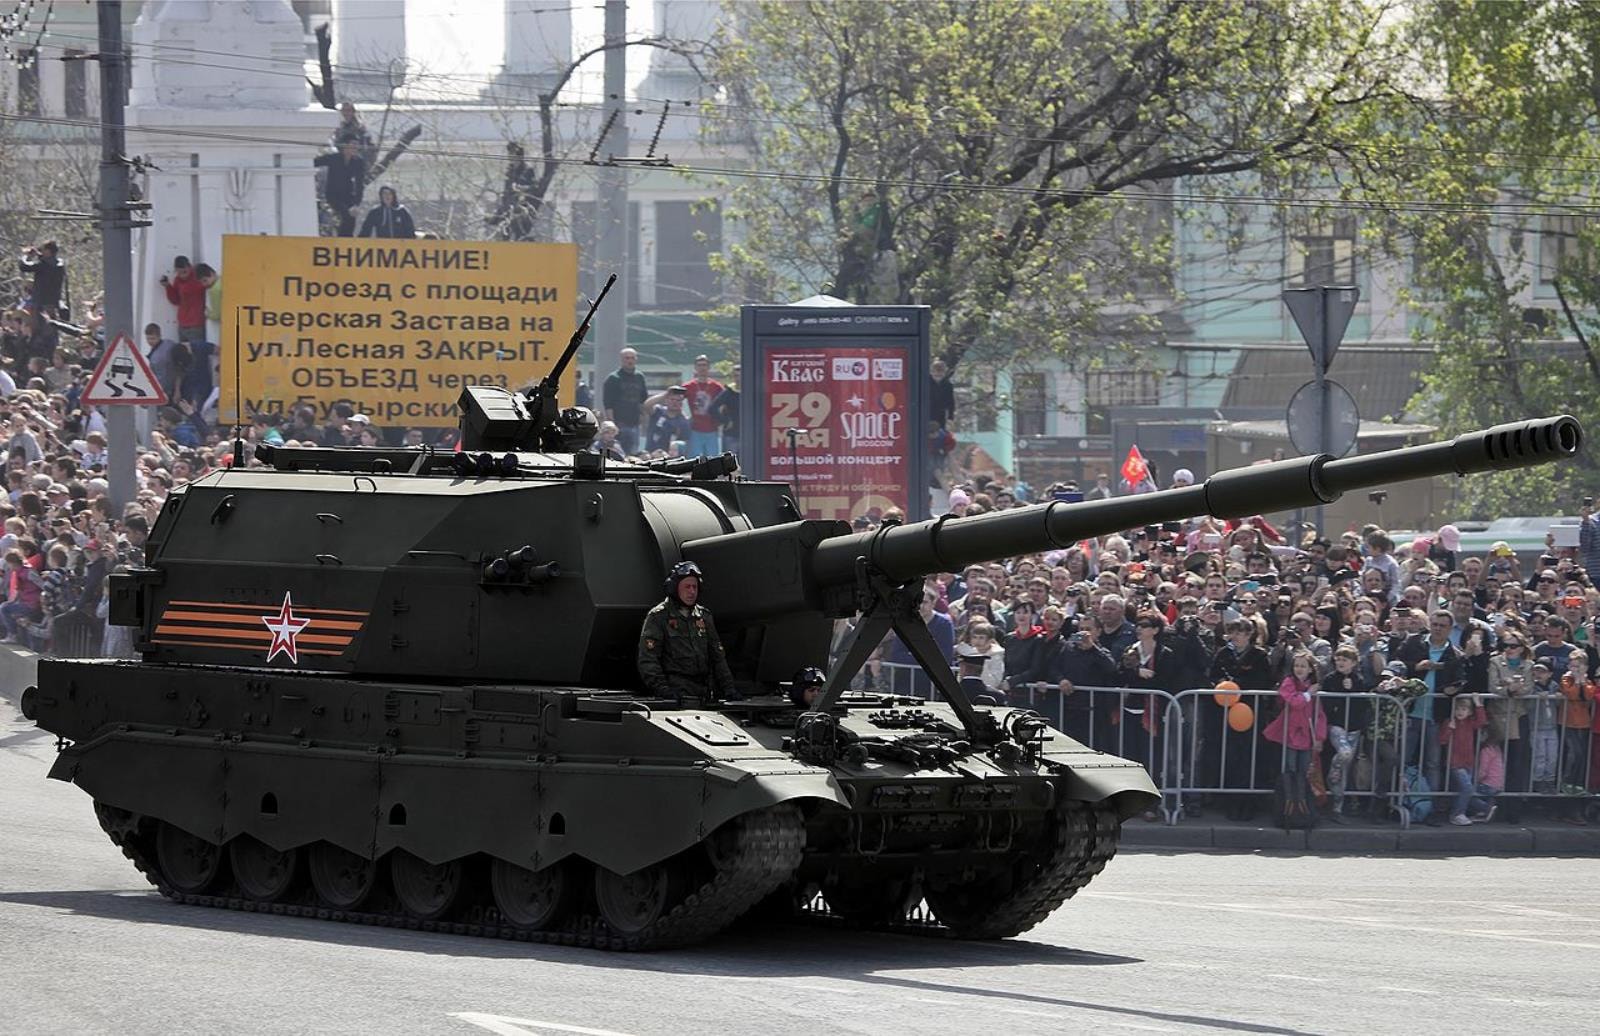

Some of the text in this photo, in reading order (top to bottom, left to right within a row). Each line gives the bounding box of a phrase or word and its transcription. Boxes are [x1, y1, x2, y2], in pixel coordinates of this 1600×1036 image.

[313, 247, 489, 270] ВНИМАНИЕ!
[283, 276, 557, 305] Проезд с площади
[242, 306, 553, 332] Тверская Застава на
[247, 338, 549, 362] ул.Лесная ЗАКРЫТ.
[292, 368, 508, 392] ОБЪЕЗД через
[771, 392, 831, 428] 29
[771, 428, 829, 448] МАЯ
[771, 454, 902, 466] БОЛЬШОЙ КОНЦЕРТ
